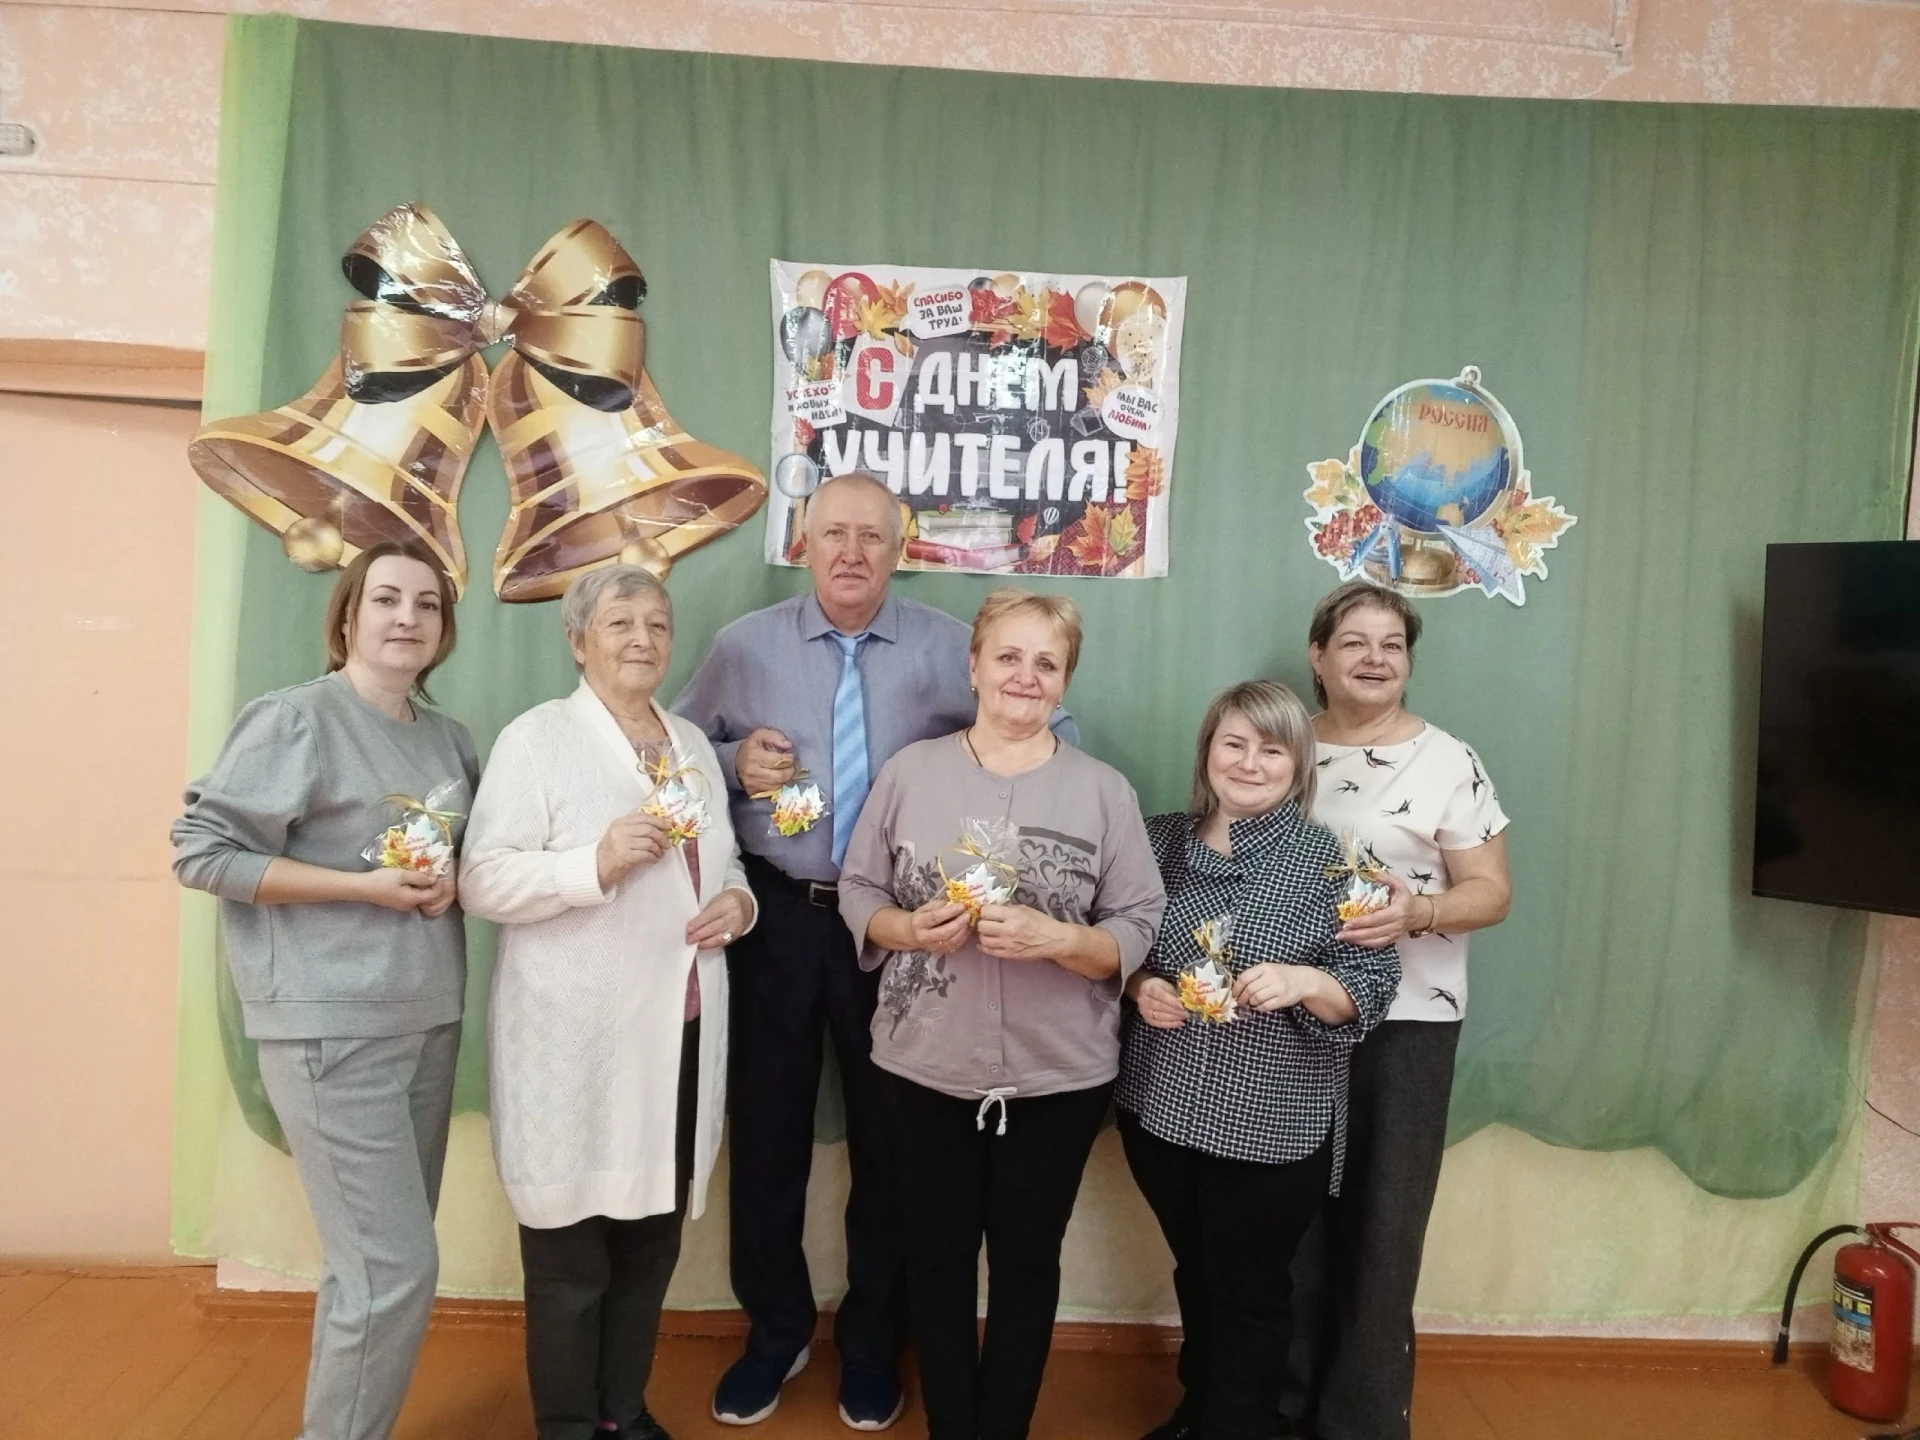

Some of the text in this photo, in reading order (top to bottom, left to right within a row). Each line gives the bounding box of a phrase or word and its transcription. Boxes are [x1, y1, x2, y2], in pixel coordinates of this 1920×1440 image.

[914, 291, 963, 307] СПАСИБО
[919, 303, 963, 320] ЗА ВАШ
[928, 316, 963, 330] ТРУД!
[856, 347, 894, 410] С
[1116, 392, 1158, 413] МЫ ВАС
[1108, 408, 1152, 431] ЛЮБИМ!
[823, 429, 1134, 503] УЧИТЕЛЯ!
